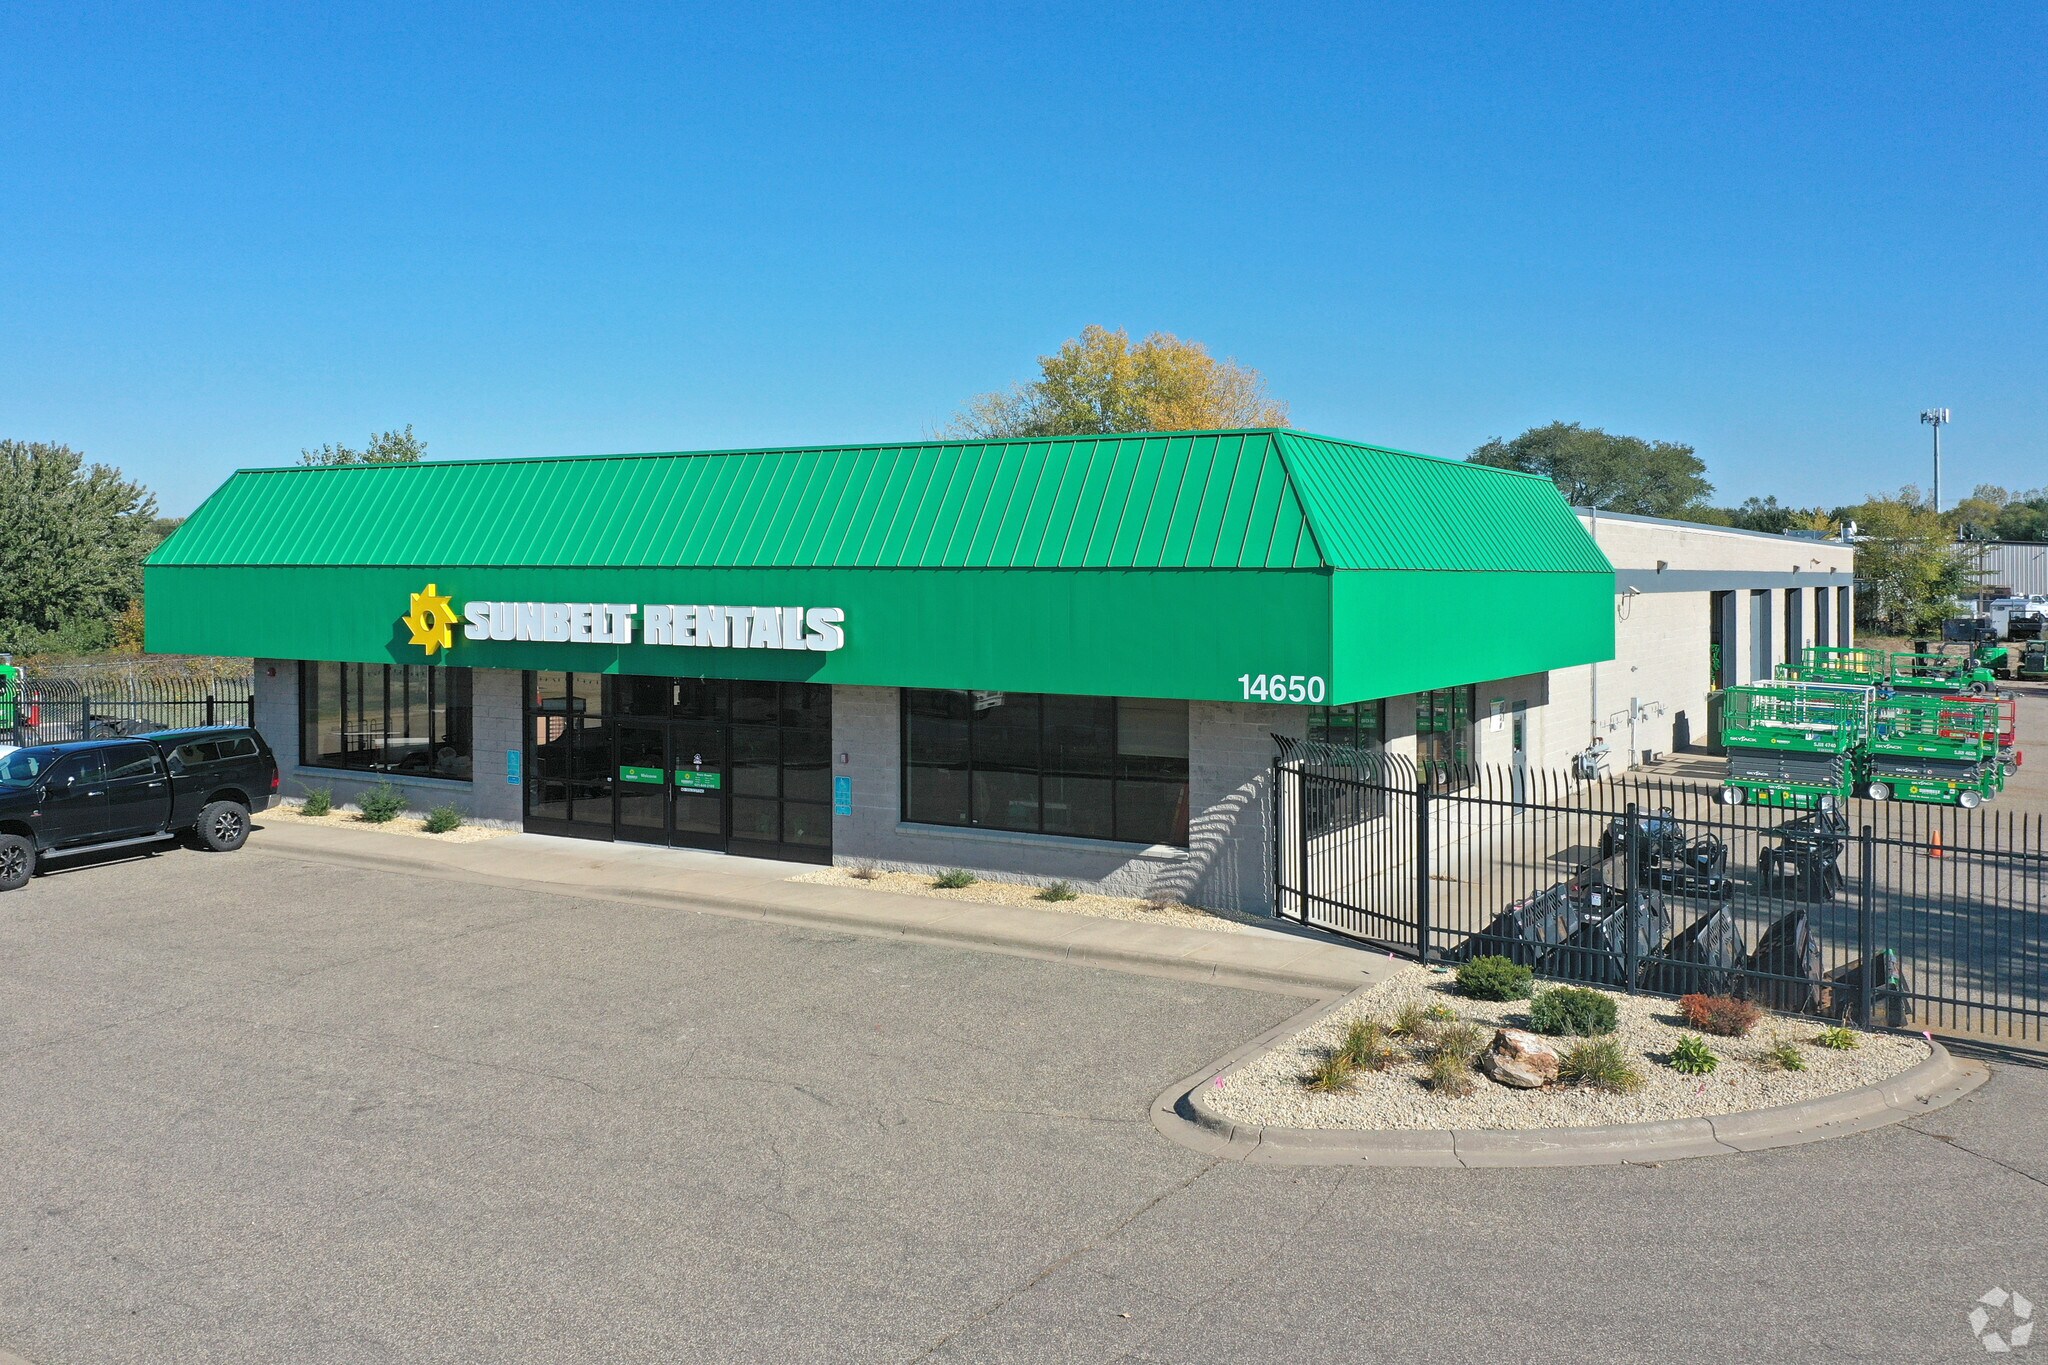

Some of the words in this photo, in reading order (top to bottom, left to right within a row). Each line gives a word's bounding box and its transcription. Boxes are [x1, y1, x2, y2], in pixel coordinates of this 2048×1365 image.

[464, 601, 637, 644] SUNBELT
[643, 603, 844, 652] RENTALS
[1238, 673, 1326, 703] 14650
